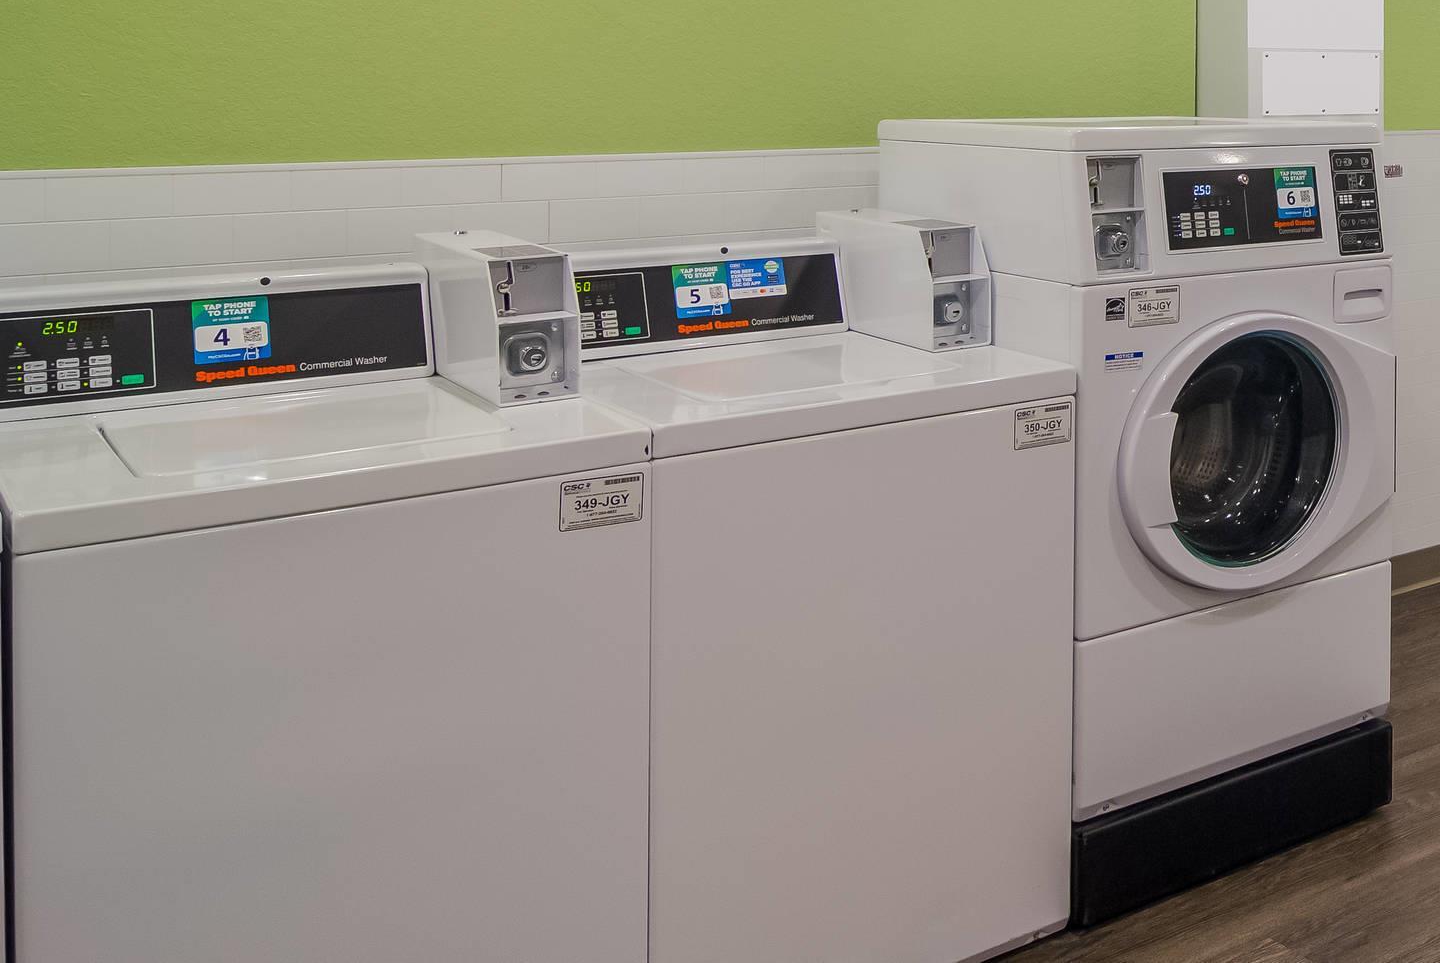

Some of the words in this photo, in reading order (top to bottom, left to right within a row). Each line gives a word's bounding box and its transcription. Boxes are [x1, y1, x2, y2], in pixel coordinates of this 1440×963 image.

[1287, 191, 1296, 205] 6
[690, 289, 700, 304] 5
[203, 303, 222, 311] TAP
[223, 301, 257, 310] PHONE
[223, 308, 253, 316] START
[1137, 301, 1171, 313] 346-JGY
[42, 320, 78, 335] 2.50
[677, 321, 713, 334] Speed
[714, 319, 749, 330] Queen
[751, 315, 790, 326] Commercial
[790, 313, 815, 322] Washer
[213, 328, 231, 346] 4
[195, 367, 246, 383] Speed
[247, 363, 297, 376] Queen
[299, 358, 354, 372] Commercial
[354, 355, 388, 366] Washer
[1024, 418, 1063, 433] 350-JGY
[564, 483, 585, 492] CSC
[574, 493, 630, 511] 349-JGY
